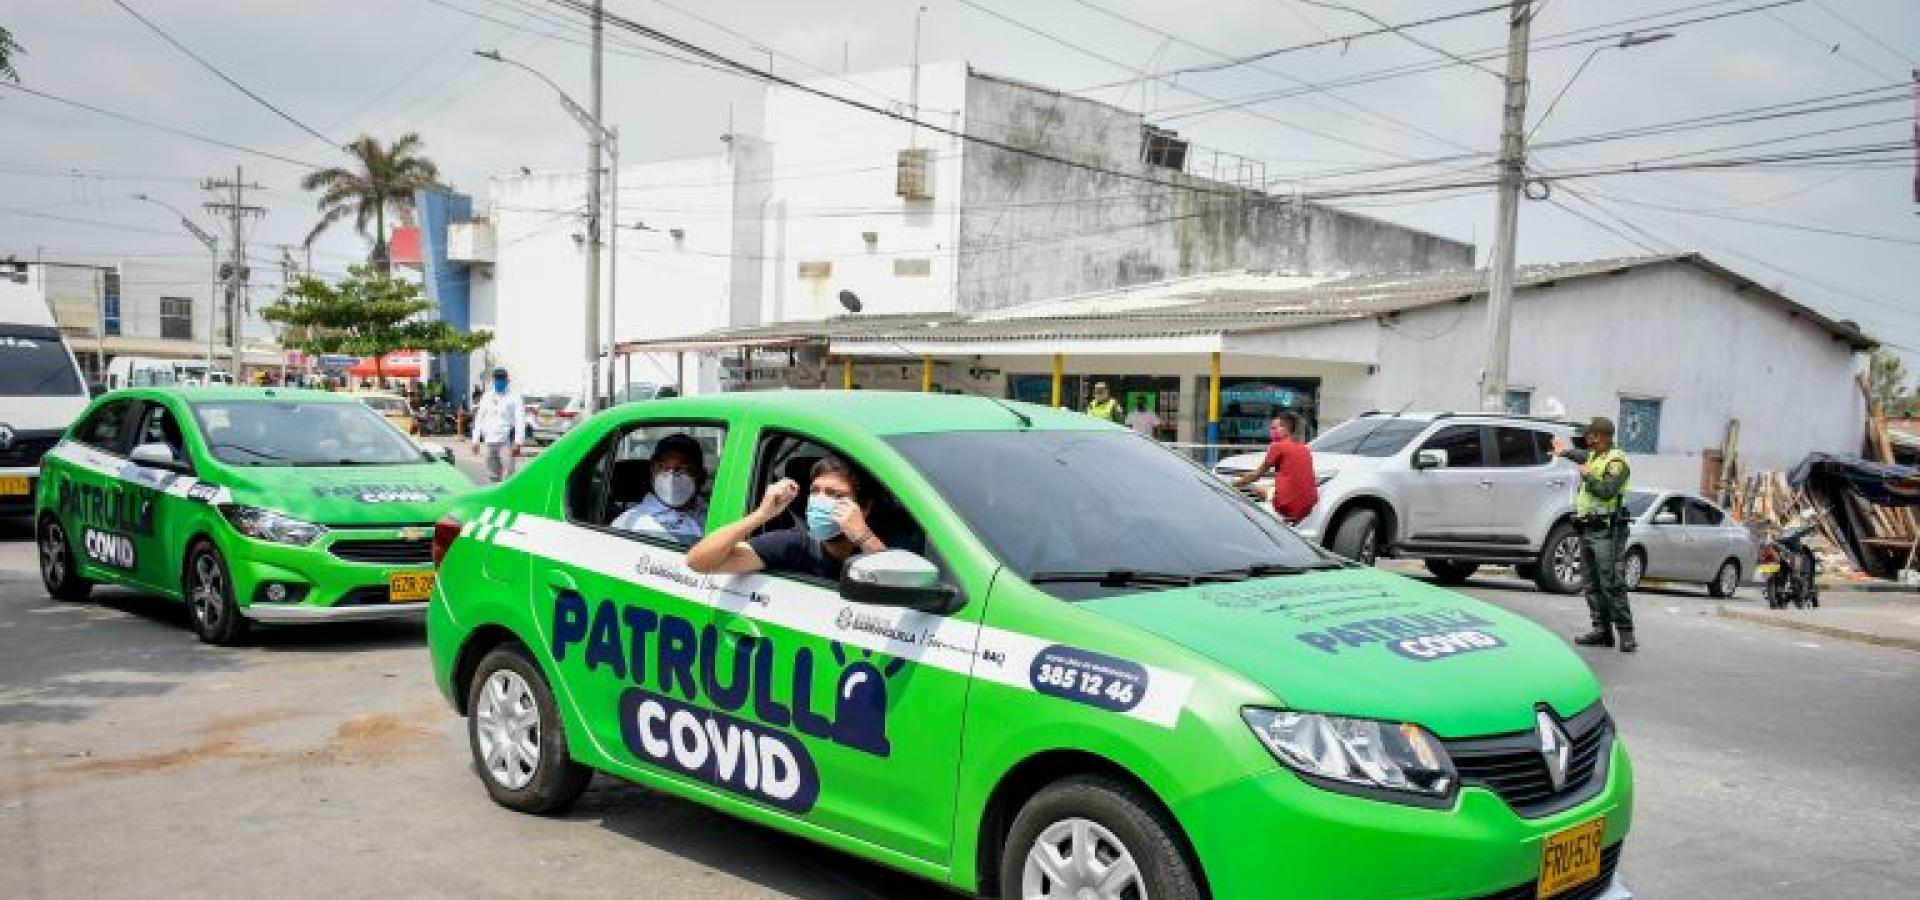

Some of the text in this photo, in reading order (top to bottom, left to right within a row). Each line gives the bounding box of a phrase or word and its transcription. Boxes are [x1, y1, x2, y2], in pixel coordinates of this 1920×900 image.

[85, 529, 134, 568] COVID
[1037, 664, 1079, 688] 385
[1080, 672, 1104, 695] 12
[1104, 681, 1134, 702] 46
[637, 699, 802, 801] COVID
